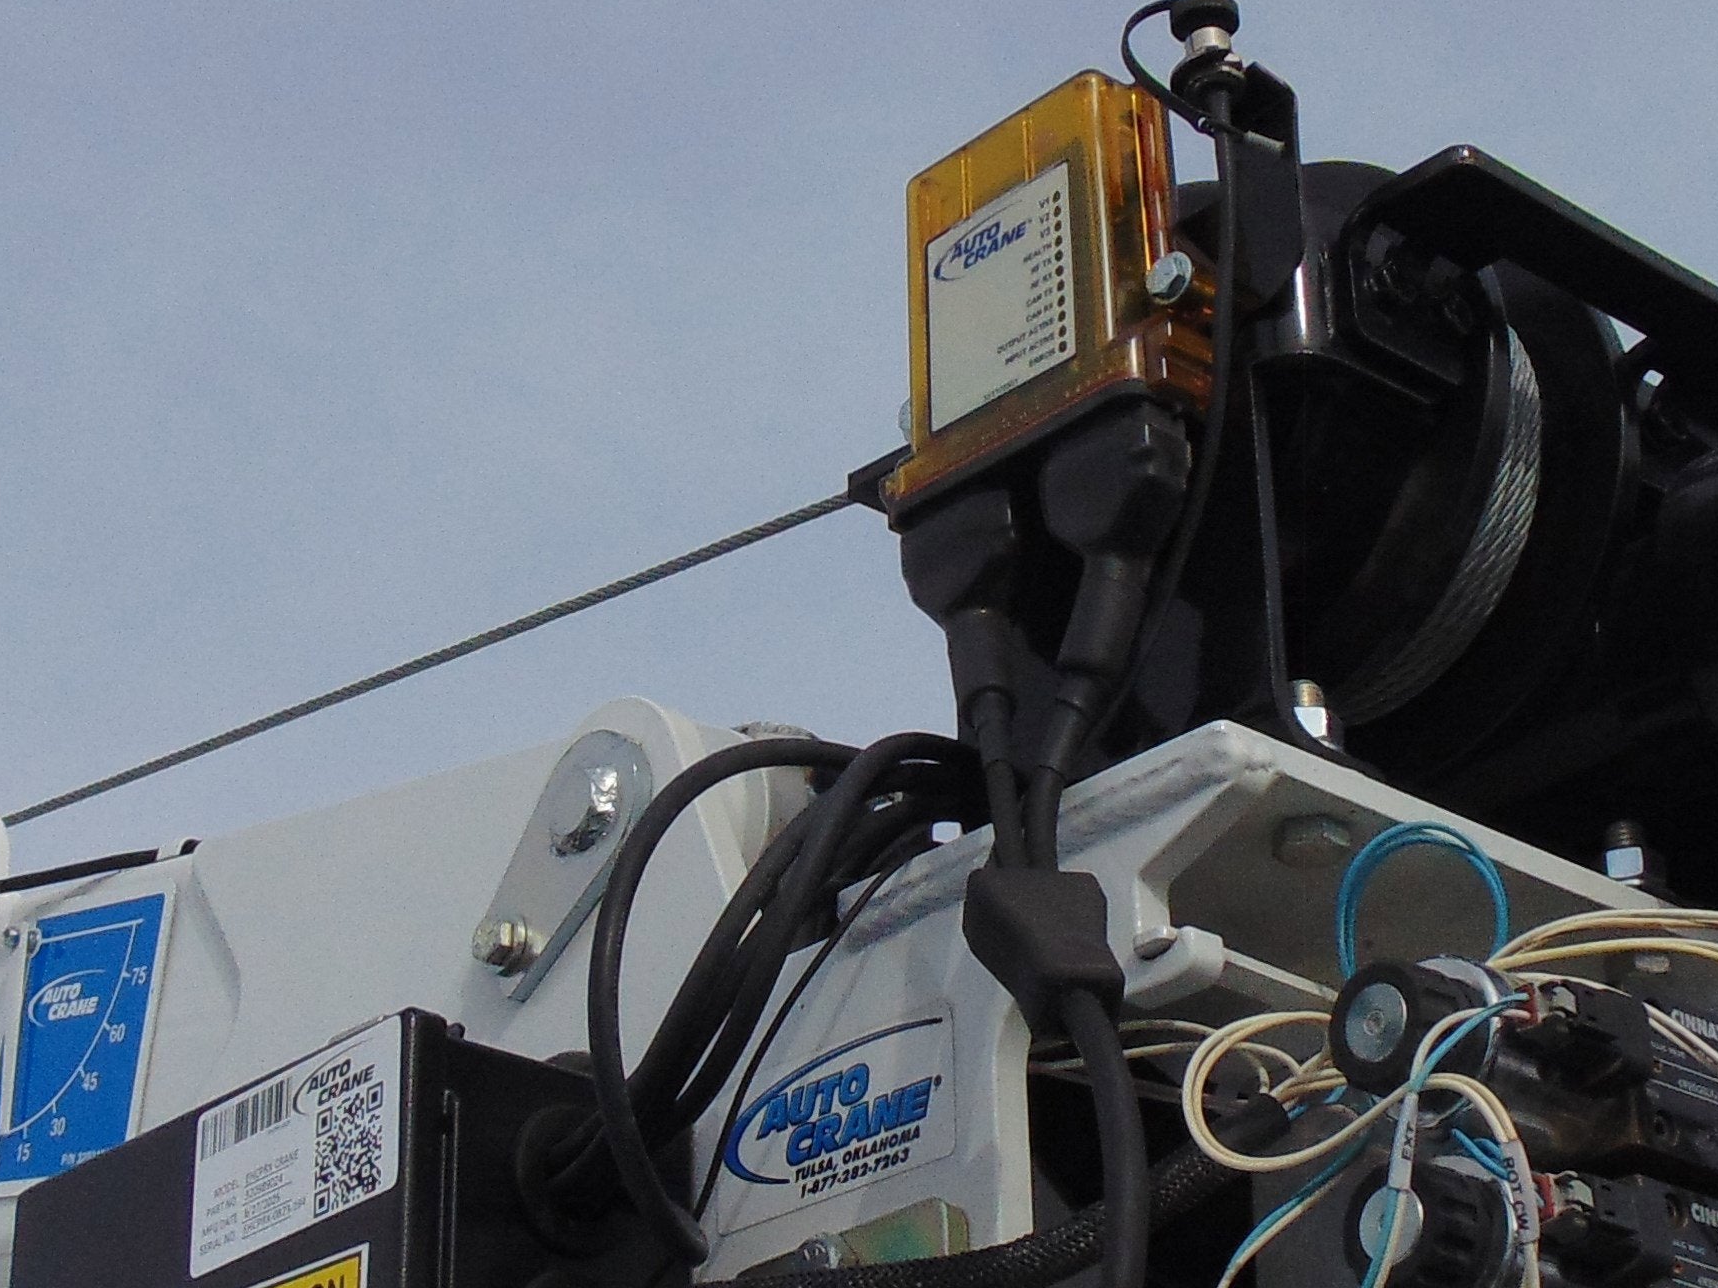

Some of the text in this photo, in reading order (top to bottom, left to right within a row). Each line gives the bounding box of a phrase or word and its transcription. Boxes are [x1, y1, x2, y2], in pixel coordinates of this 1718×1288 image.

[950, 221, 1001, 263] AUTO
[964, 221, 1027, 269] CRANE
[41, 982, 82, 1005] AUTO
[132, 966, 148, 985] 75
[48, 996, 99, 1021] CRANE
[109, 1023, 125, 1042] 60
[82, 1072, 98, 1091] 45
[306, 1058, 351, 1094] AUTO
[317, 1063, 375, 1106] CRANE
[756, 1063, 870, 1140] AUTO
[50, 1117, 66, 1136] 30
[786, 1076, 933, 1166] CRANE
[16, 1143, 31, 1162] 15
[795, 1125, 921, 1183] TULSA, OKLAHOMA
[1401, 1121, 1416, 1161] EXT
[801, 1148, 911, 1198] 1-877-282-7263
[1514, 1200, 1530, 1231] CW
